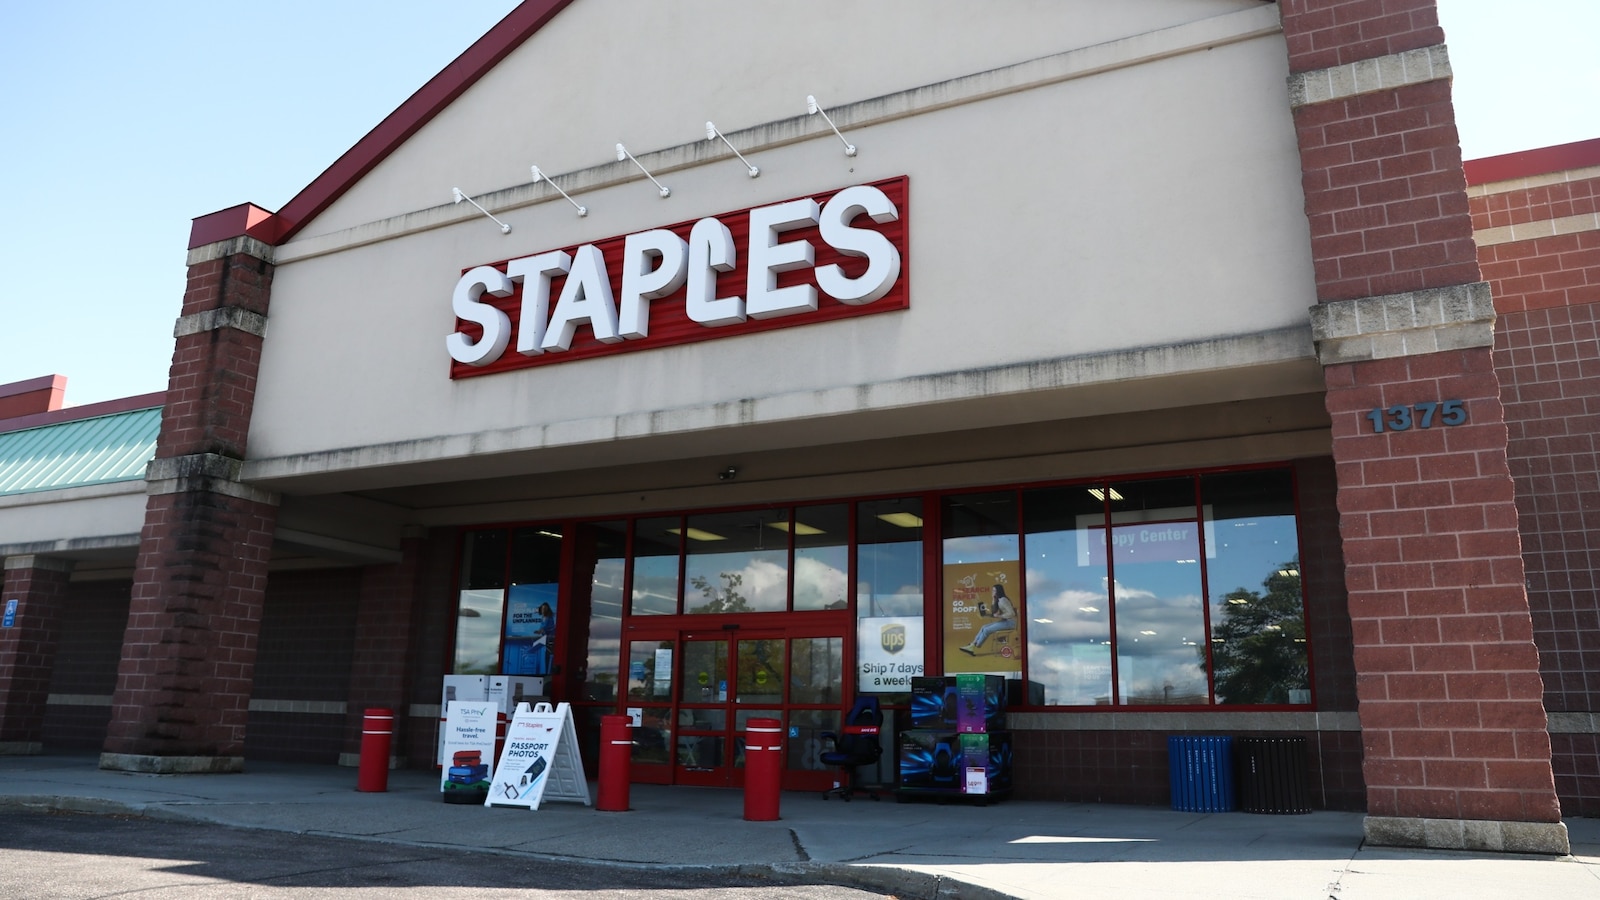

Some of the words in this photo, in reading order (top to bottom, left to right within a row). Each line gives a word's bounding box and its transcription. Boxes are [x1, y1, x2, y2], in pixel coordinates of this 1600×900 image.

[446, 185, 902, 367] STAPLES
[1367, 400, 1466, 433] 1375
[1140, 528, 1188, 543] Center
[882, 633, 904, 650] ups
[863, 662, 887, 675] Ship
[889, 663, 896, 673] 7
[897, 662, 924, 675] days
[874, 677, 881, 686] a
[510, 742, 549, 751] PASSPORT
[508, 750, 539, 758] PHOTOS
